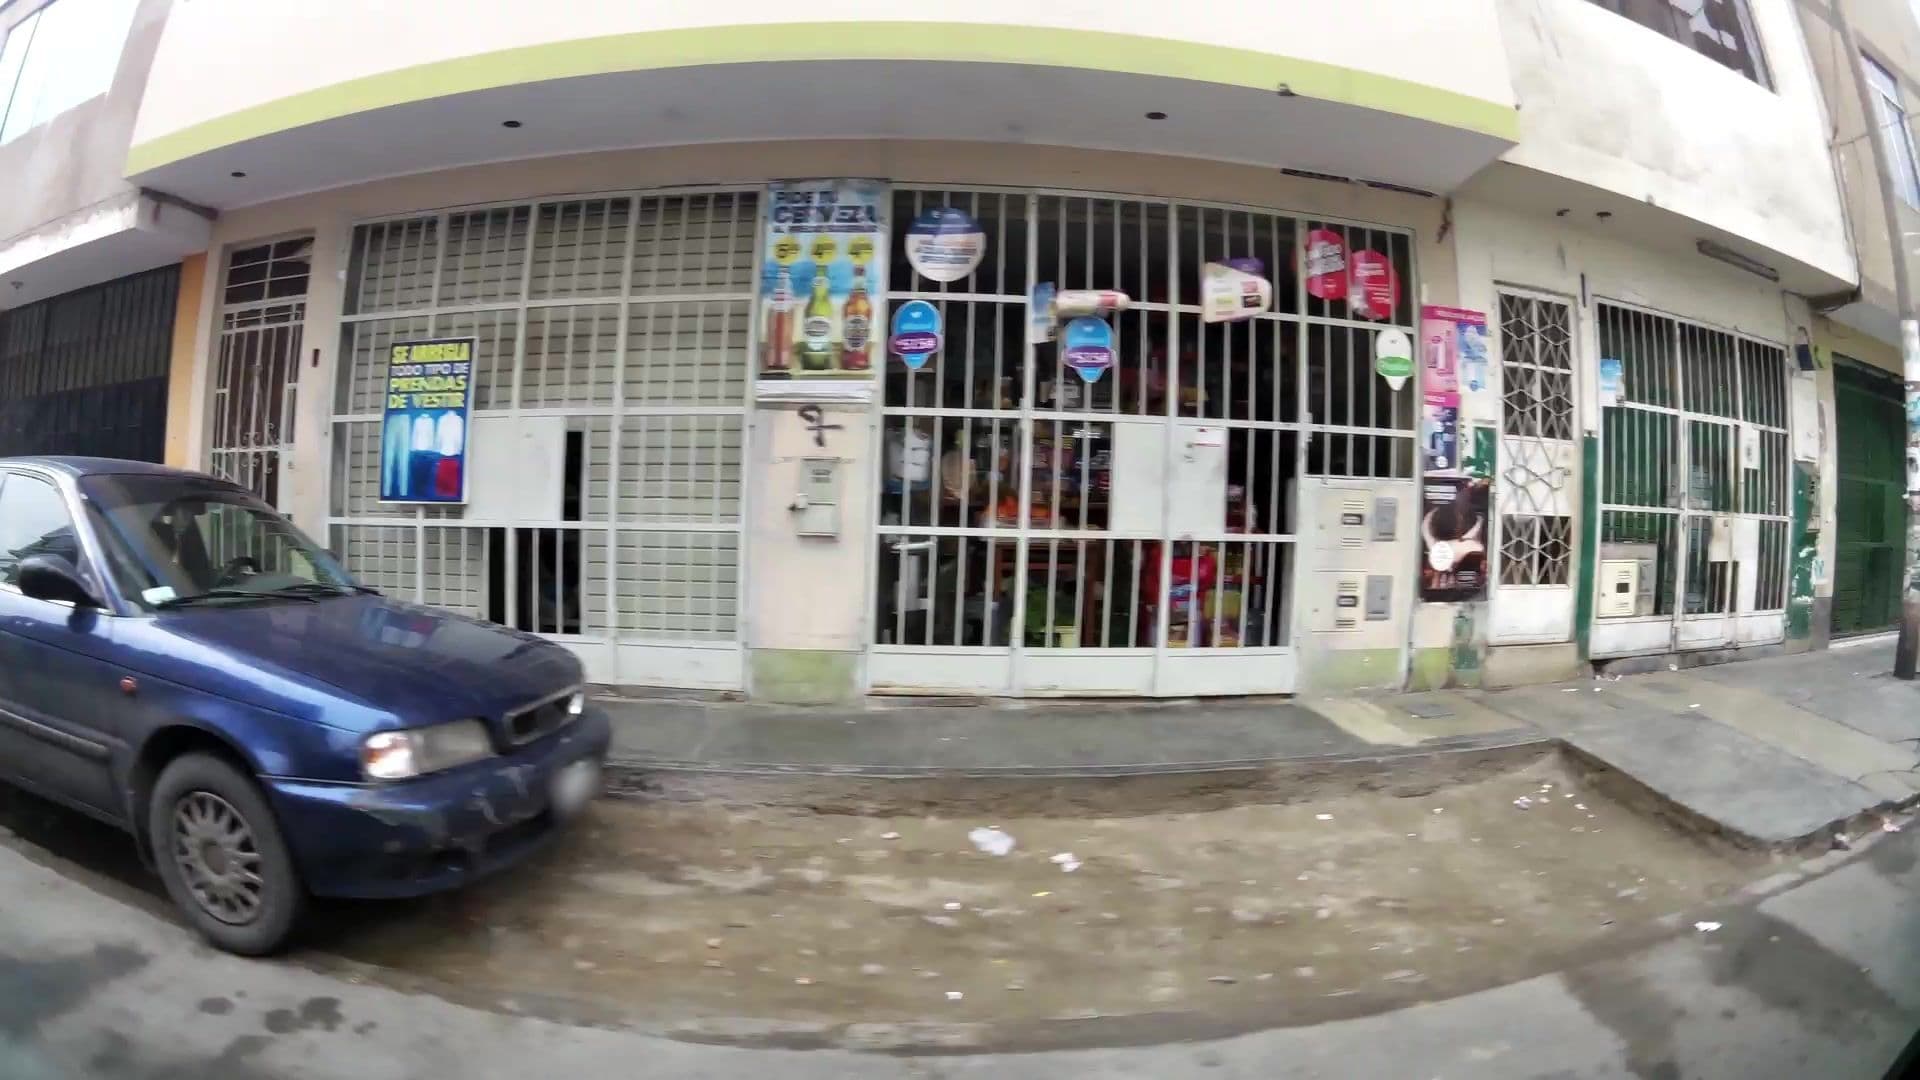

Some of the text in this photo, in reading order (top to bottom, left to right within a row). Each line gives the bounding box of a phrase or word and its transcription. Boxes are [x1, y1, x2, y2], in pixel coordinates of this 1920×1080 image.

[392, 346, 409, 364] SE
[391, 362, 469, 376] TODO TIPO DE
[390, 375, 466, 392] PRENDAS
[388, 392, 465, 409] DE VESTIR
